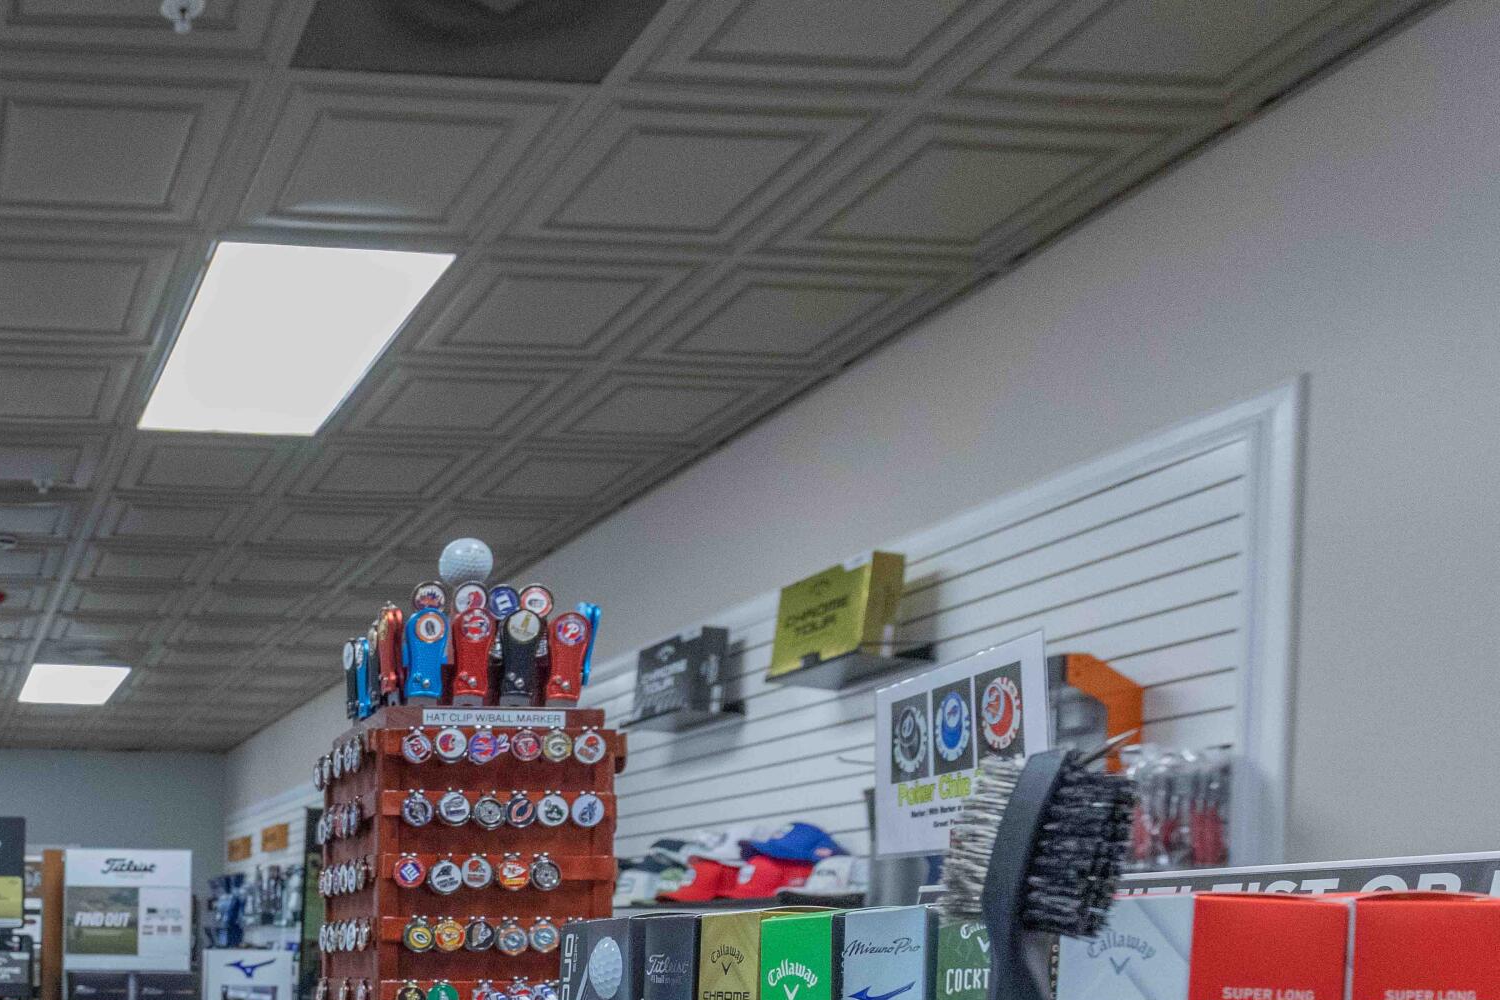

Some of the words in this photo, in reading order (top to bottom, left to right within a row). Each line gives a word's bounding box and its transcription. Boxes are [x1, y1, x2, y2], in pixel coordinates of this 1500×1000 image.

[426, 713, 446, 722] HAT
[449, 713, 472, 722] CLIP
[476, 713, 514, 723] W/BALL
[517, 714, 561, 723] MARKER
[101, 858, 157, 874] Titleist
[104, 911, 131, 927] OUT
[844, 939, 894, 957] Mizuno
[893, 937, 921, 956] Pro
[1086, 928, 1157, 960] Callaway
[710, 944, 744, 965] Callaway
[646, 953, 690, 976] Titleist
[768, 959, 818, 989] Callaway
[702, 991, 750, 1000] CHROME
[1222, 987, 1272, 1000] SUPER
